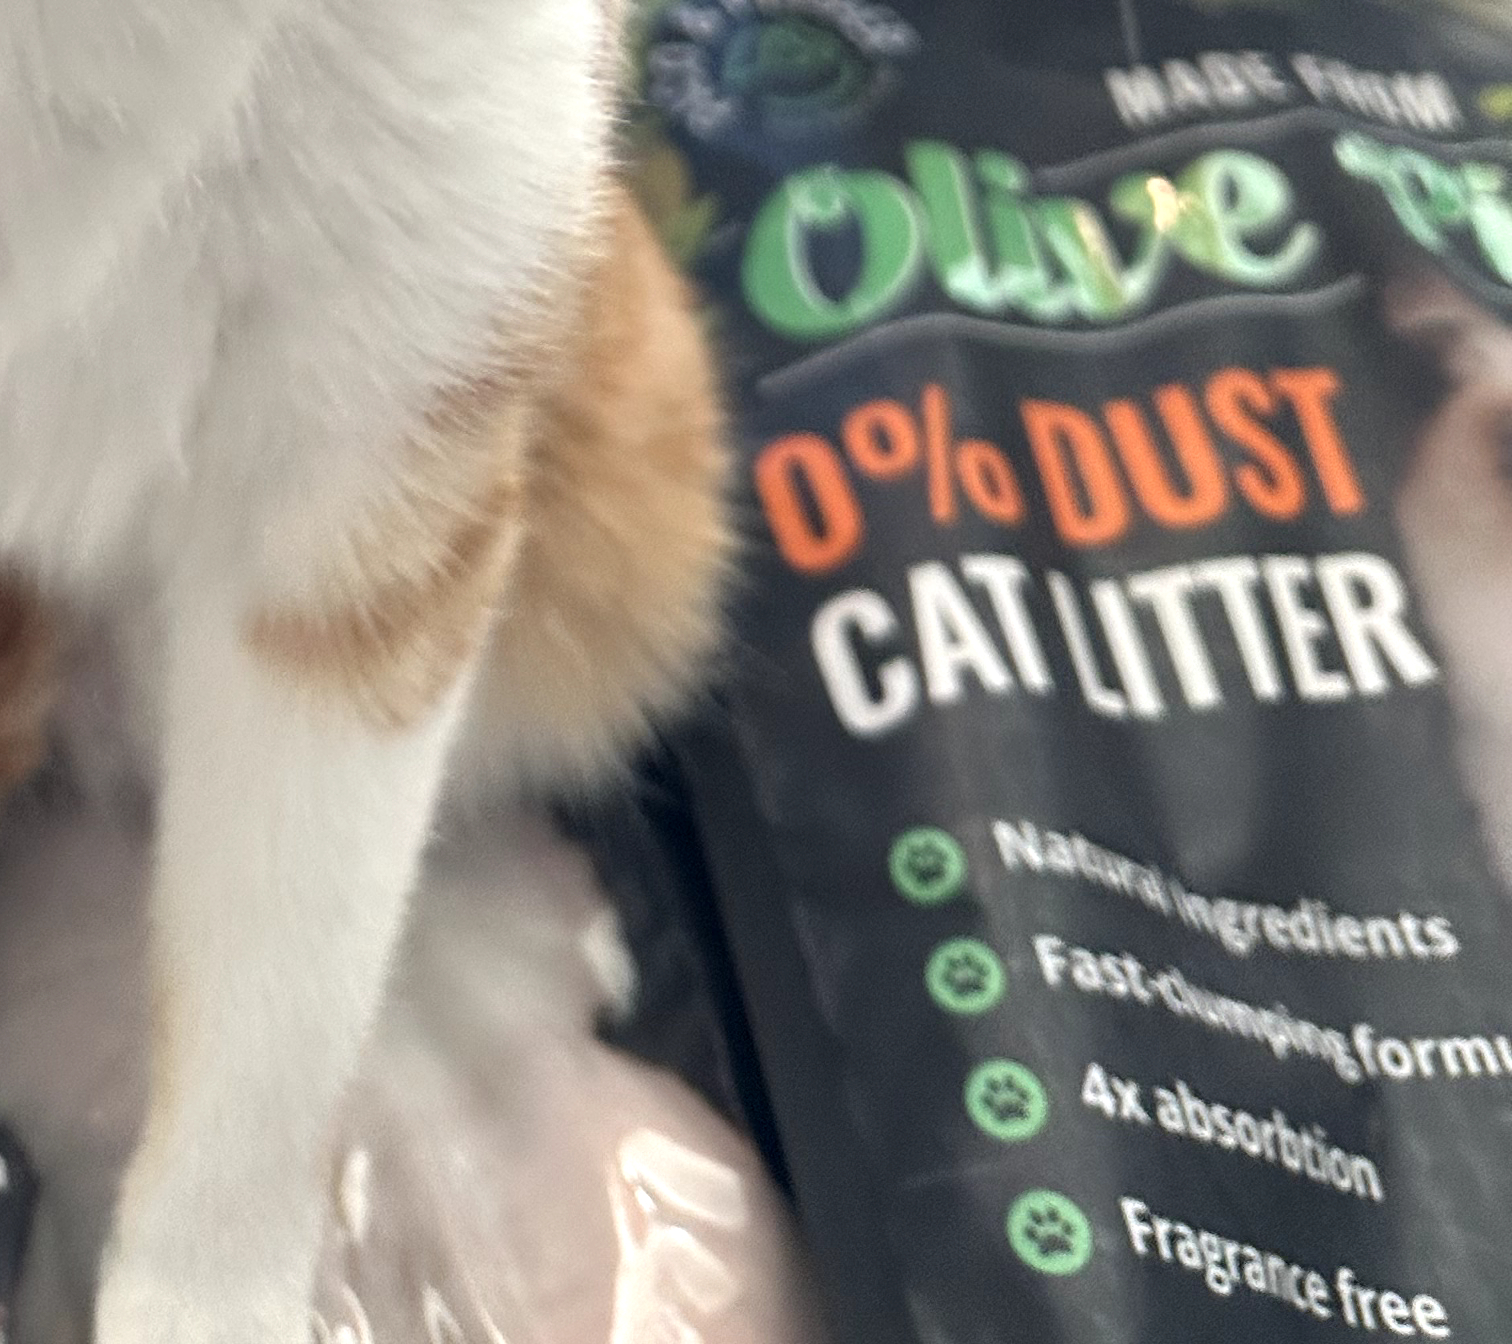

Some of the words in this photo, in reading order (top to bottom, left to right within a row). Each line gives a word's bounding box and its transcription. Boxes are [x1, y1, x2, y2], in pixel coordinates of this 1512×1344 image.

[1103, 49, 1293, 130] MADE
[741, 137, 1324, 342] Olive
[752, 382, 1027, 577] 0%
[1018, 365, 1368, 552] DUST
[809, 551, 1055, 740] CAT
[1044, 550, 1441, 721] LITTER
[991, 817, 1174, 918] Natural
[1082, 1062, 1152, 1126] 4x
[1119, 1195, 1333, 1320] Fragrance
[1336, 1266, 1452, 1340] free
